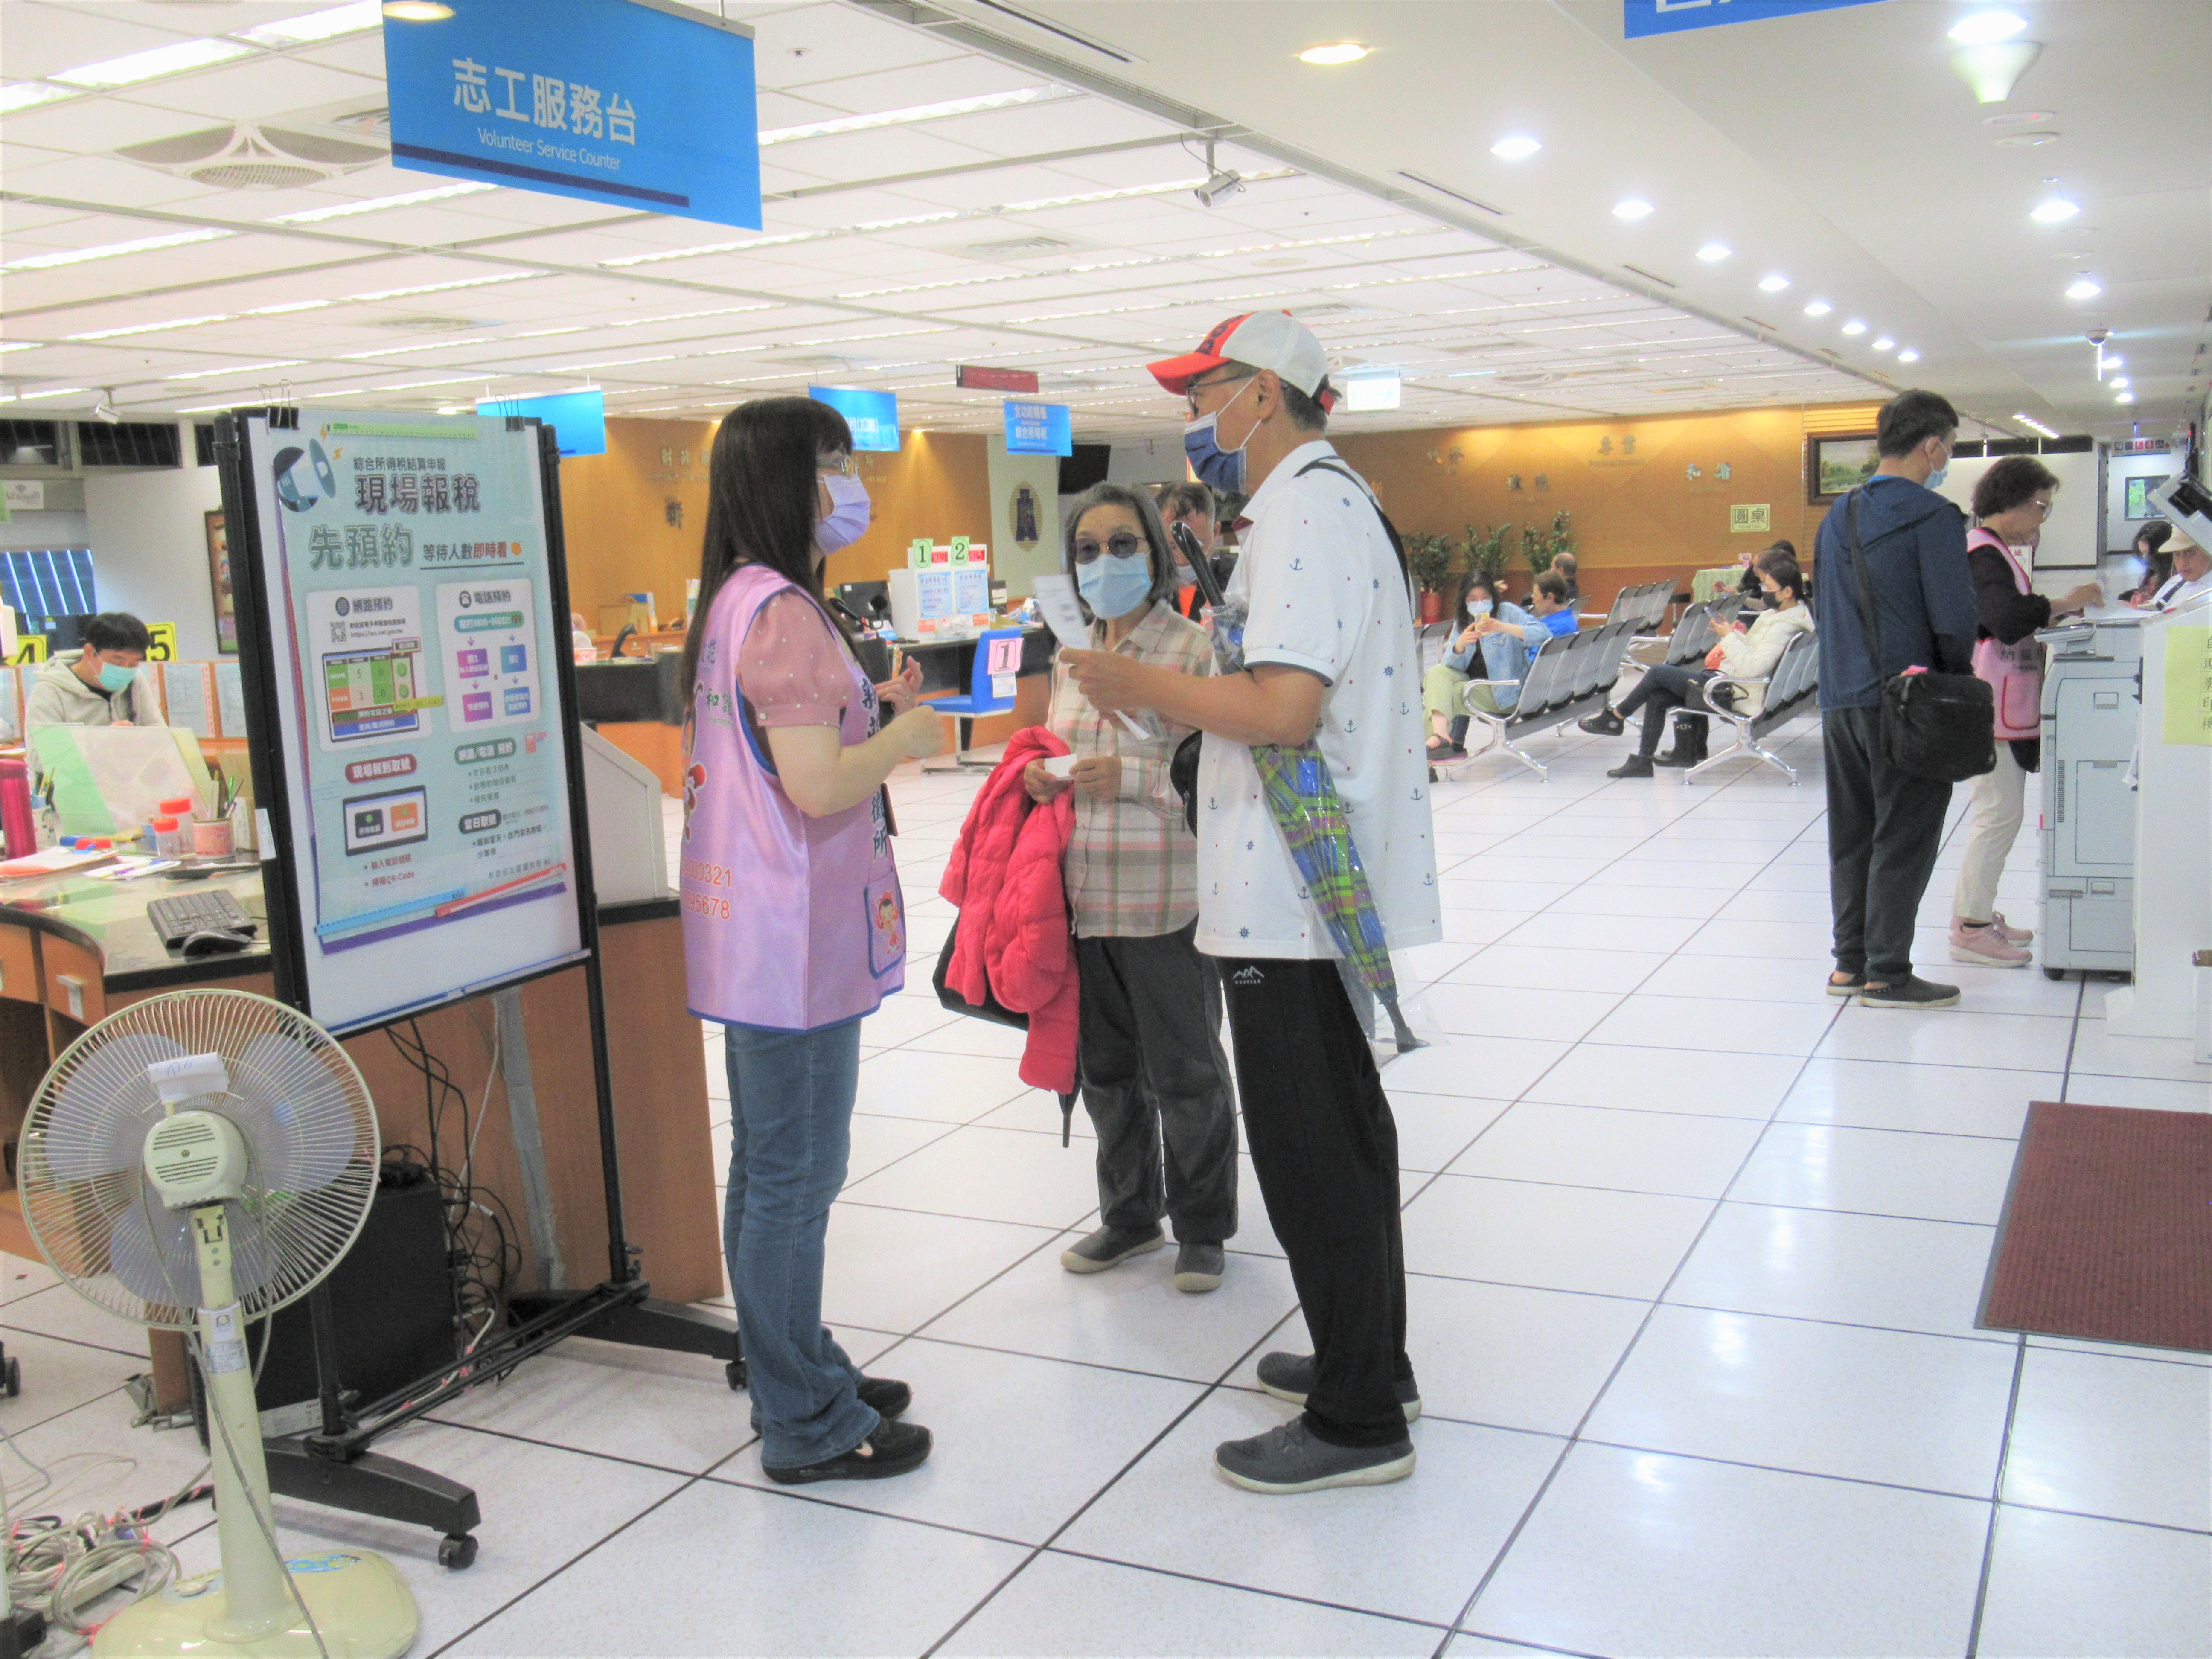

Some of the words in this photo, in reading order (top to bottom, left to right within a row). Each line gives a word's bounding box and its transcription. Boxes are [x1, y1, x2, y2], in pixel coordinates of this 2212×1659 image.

[452, 57, 636, 146] 志工服務台
[478, 127, 533, 154] Volunteer
[538, 140, 577, 163] Service
[579, 148, 620, 170] Counter
[354, 457, 445, 471] 綜合所得稅結算申報
[356, 473, 480, 514] 現場報稅
[1734, 509, 1766, 524] 圓桌
[309, 524, 413, 570] 先預約
[423, 541, 507, 562] 等待人數即時看
[919, 545, 926, 563] 1
[955, 543, 965, 560] 2
[352, 597, 393, 612] 網路預約
[474, 589, 511, 604] 電話預約
[150, 630, 170, 661] 5
[998, 643, 1010, 670] 1
